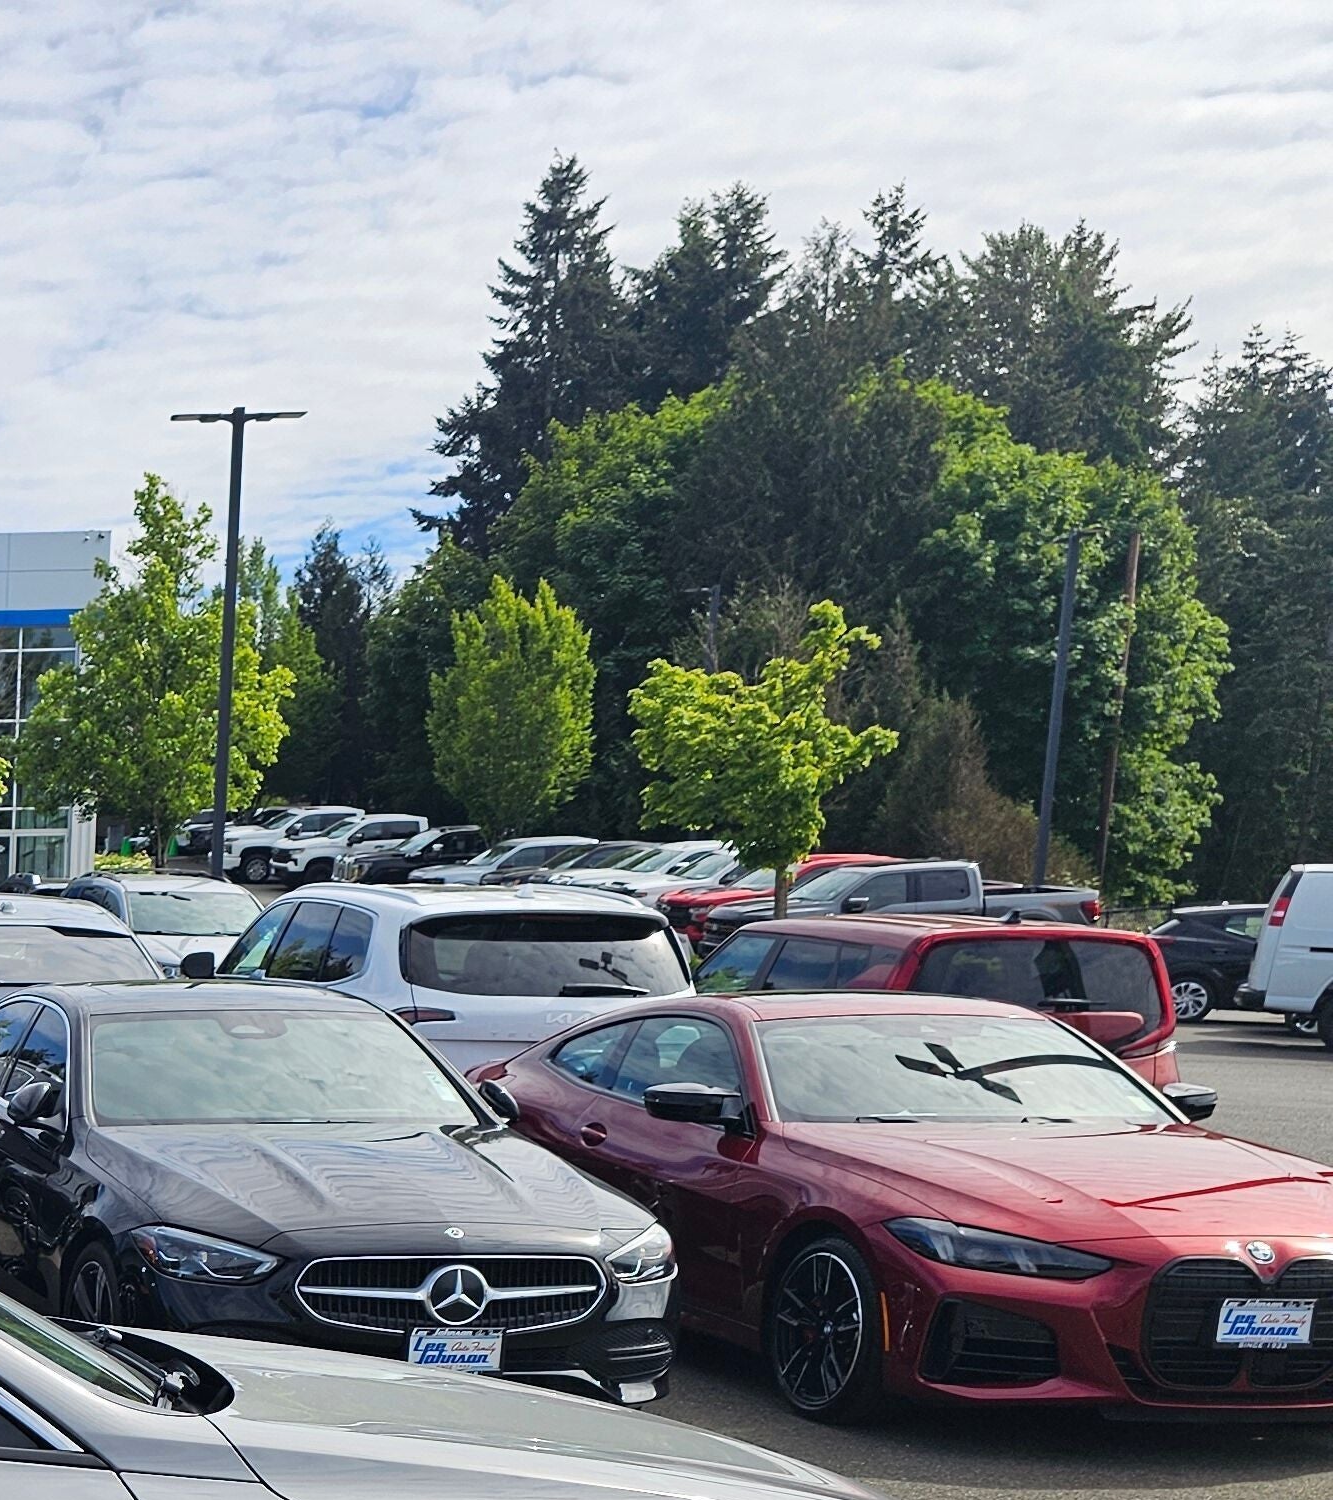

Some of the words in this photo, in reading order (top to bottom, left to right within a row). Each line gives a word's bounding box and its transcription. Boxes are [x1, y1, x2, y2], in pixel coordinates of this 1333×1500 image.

[1222, 1308, 1257, 1323] Lee
[1222, 1323, 1299, 1336] Johnson
[412, 1336, 448, 1352] Lee
[413, 1351, 490, 1365] Johnson
